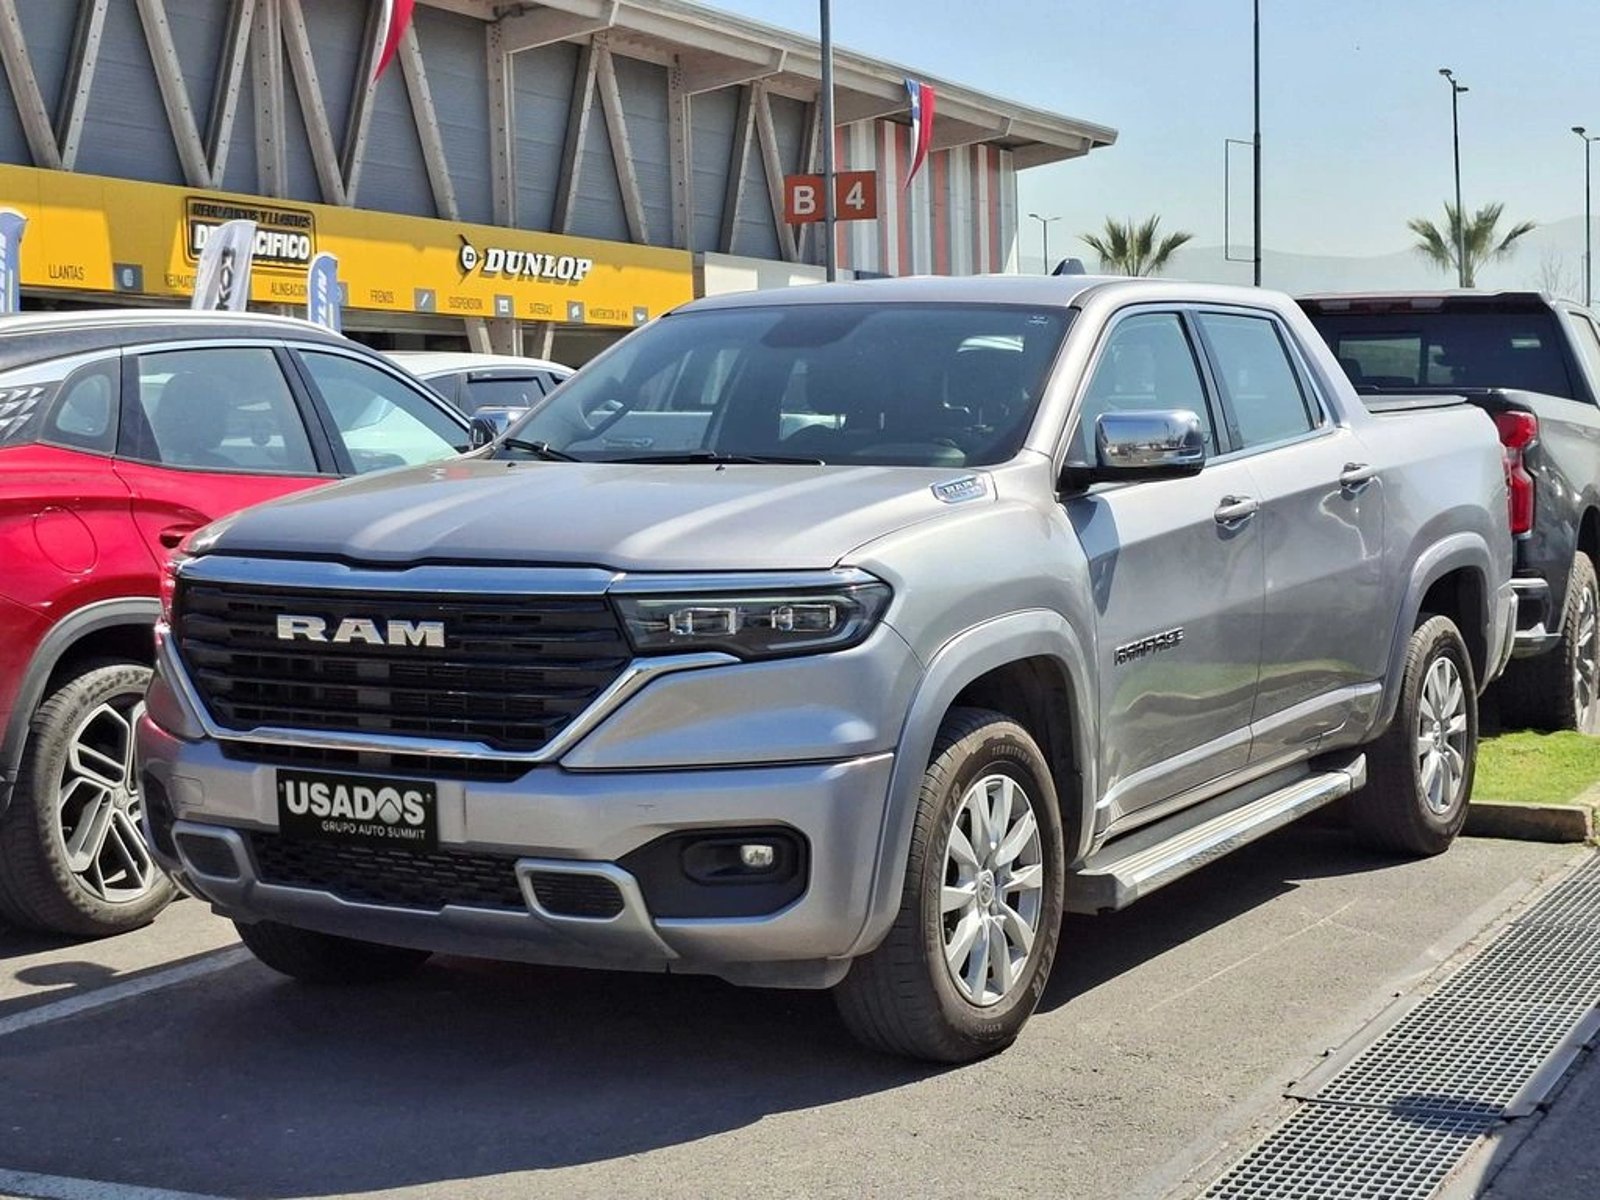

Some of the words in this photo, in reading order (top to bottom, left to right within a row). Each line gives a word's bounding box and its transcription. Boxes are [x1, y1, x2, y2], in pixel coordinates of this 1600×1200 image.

[793, 185, 816, 215] B
[845, 181, 865, 210] 4
[251, 231, 311, 260] CIFICO
[48, 264, 85, 281] LLANTAS
[484, 248, 593, 280] DUNLOP
[369, 289, 395, 304] FRENOS
[276, 613, 445, 648] RAM
[284, 779, 426, 826] USADOS
[321, 820, 357, 835] GRUPO
[358, 824, 385, 838] AUTO
[386, 827, 426, 841] SUMMIT
